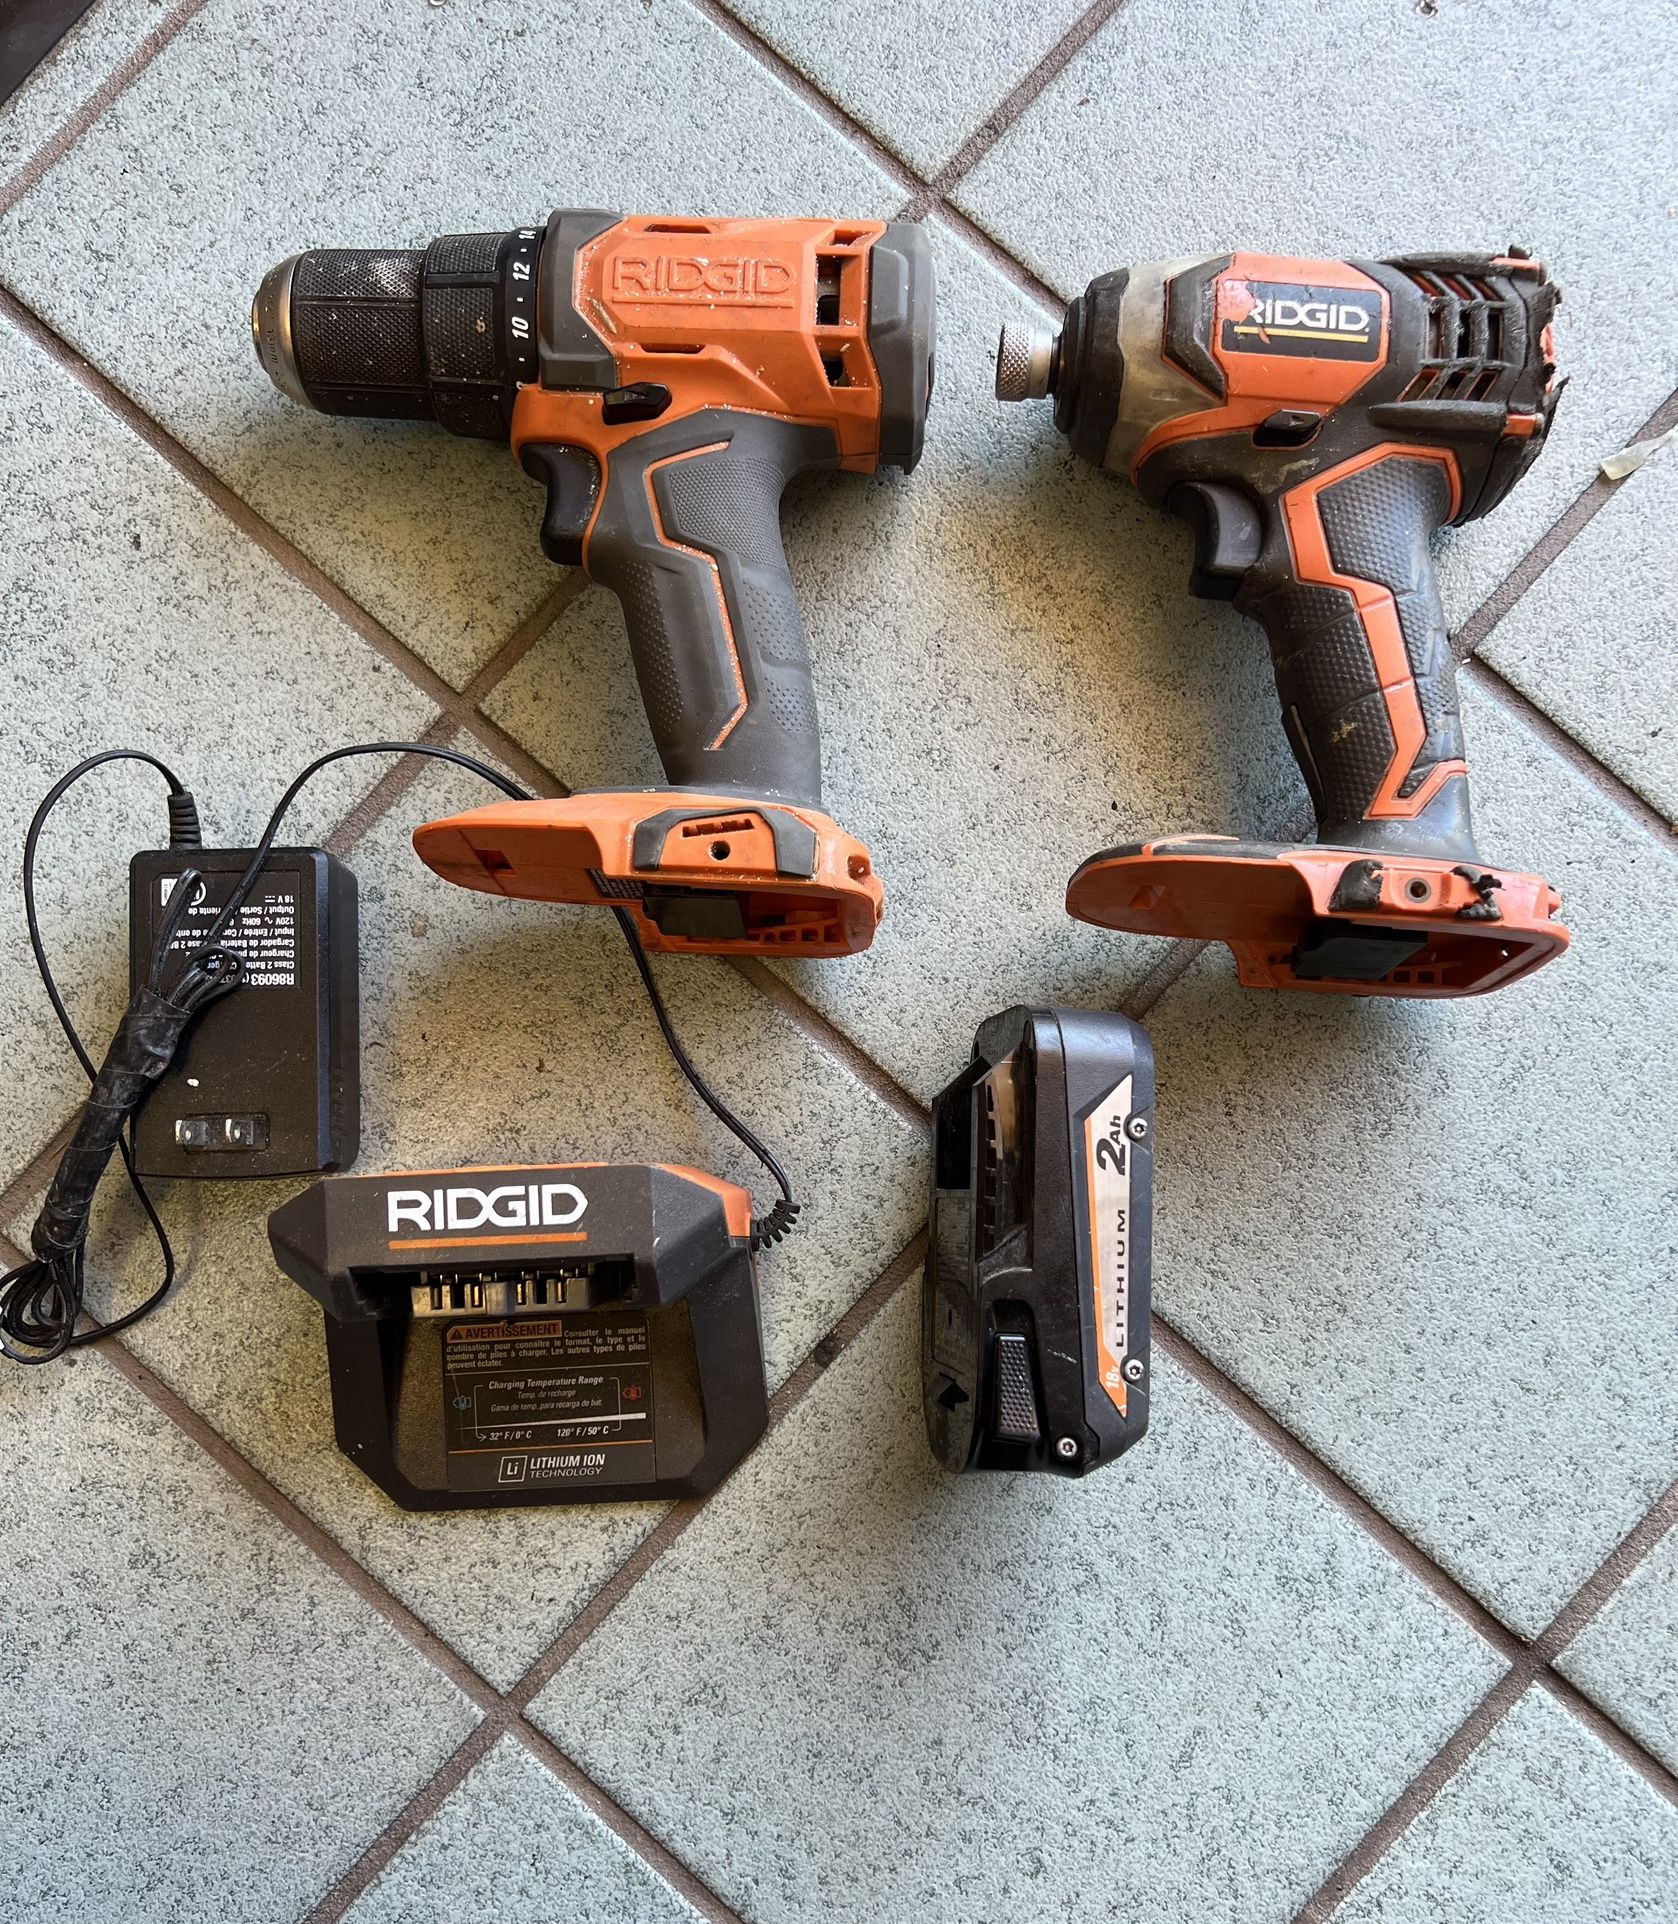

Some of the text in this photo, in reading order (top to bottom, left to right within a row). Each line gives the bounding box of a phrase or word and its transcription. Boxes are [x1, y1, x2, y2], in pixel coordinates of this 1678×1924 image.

[512, 260, 530, 281] 12
[611, 256, 798, 297] RIDGID
[510, 316, 528, 340] 10
[278, 895, 294, 903] 18 V
[269, 905, 294, 914] Output
[276, 917, 294, 925] 120V
[244, 928, 268, 936] Entrée
[275, 927, 294, 936] Input
[260, 938, 294, 947] Cargador
[260, 949, 294, 958] Chargeur
[246, 961, 265, 969] Batte
[274, 961, 294, 969] Class
[251, 973, 294, 985] R86093
[387, 1184, 588, 1232] RIDGID
[1115, 1210, 1126, 1348] LITHIUM
[465, 1323, 558, 1339] AVERTISSEMENT
[564, 1329, 599, 1337] Consulter
[605, 1328, 612, 1336] le
[447, 1344, 490, 1353] d'utilisation
[494, 1343, 511, 1352] pour
[515, 1340, 550, 1349] connaître
[554, 1339, 562, 1347] le
[596, 1336, 603, 1345] le
[607, 1335, 623, 1345] type
[638, 1334, 645, 1342] le
[447, 1342, 646, 1361] nombre de piles à charger. Les autres types de piles
[447, 1360, 504, 1370] peuvent éclater.
[488, 1376, 604, 1390] Charging Temperature Range
[518, 1389, 576, 1400] Temp. de recharge
[490, 1397, 602, 1412] Gama de temp. para recarga de bat.
[489, 1432, 504, 1440] 32°
[526, 1430, 532, 1439] C
[557, 1428, 574, 1437] 120°
[602, 1425, 609, 1434] C
[506, 1453, 606, 1476] Li LITHIUM ION
[530, 1467, 603, 1479] TECHNOLOGY
